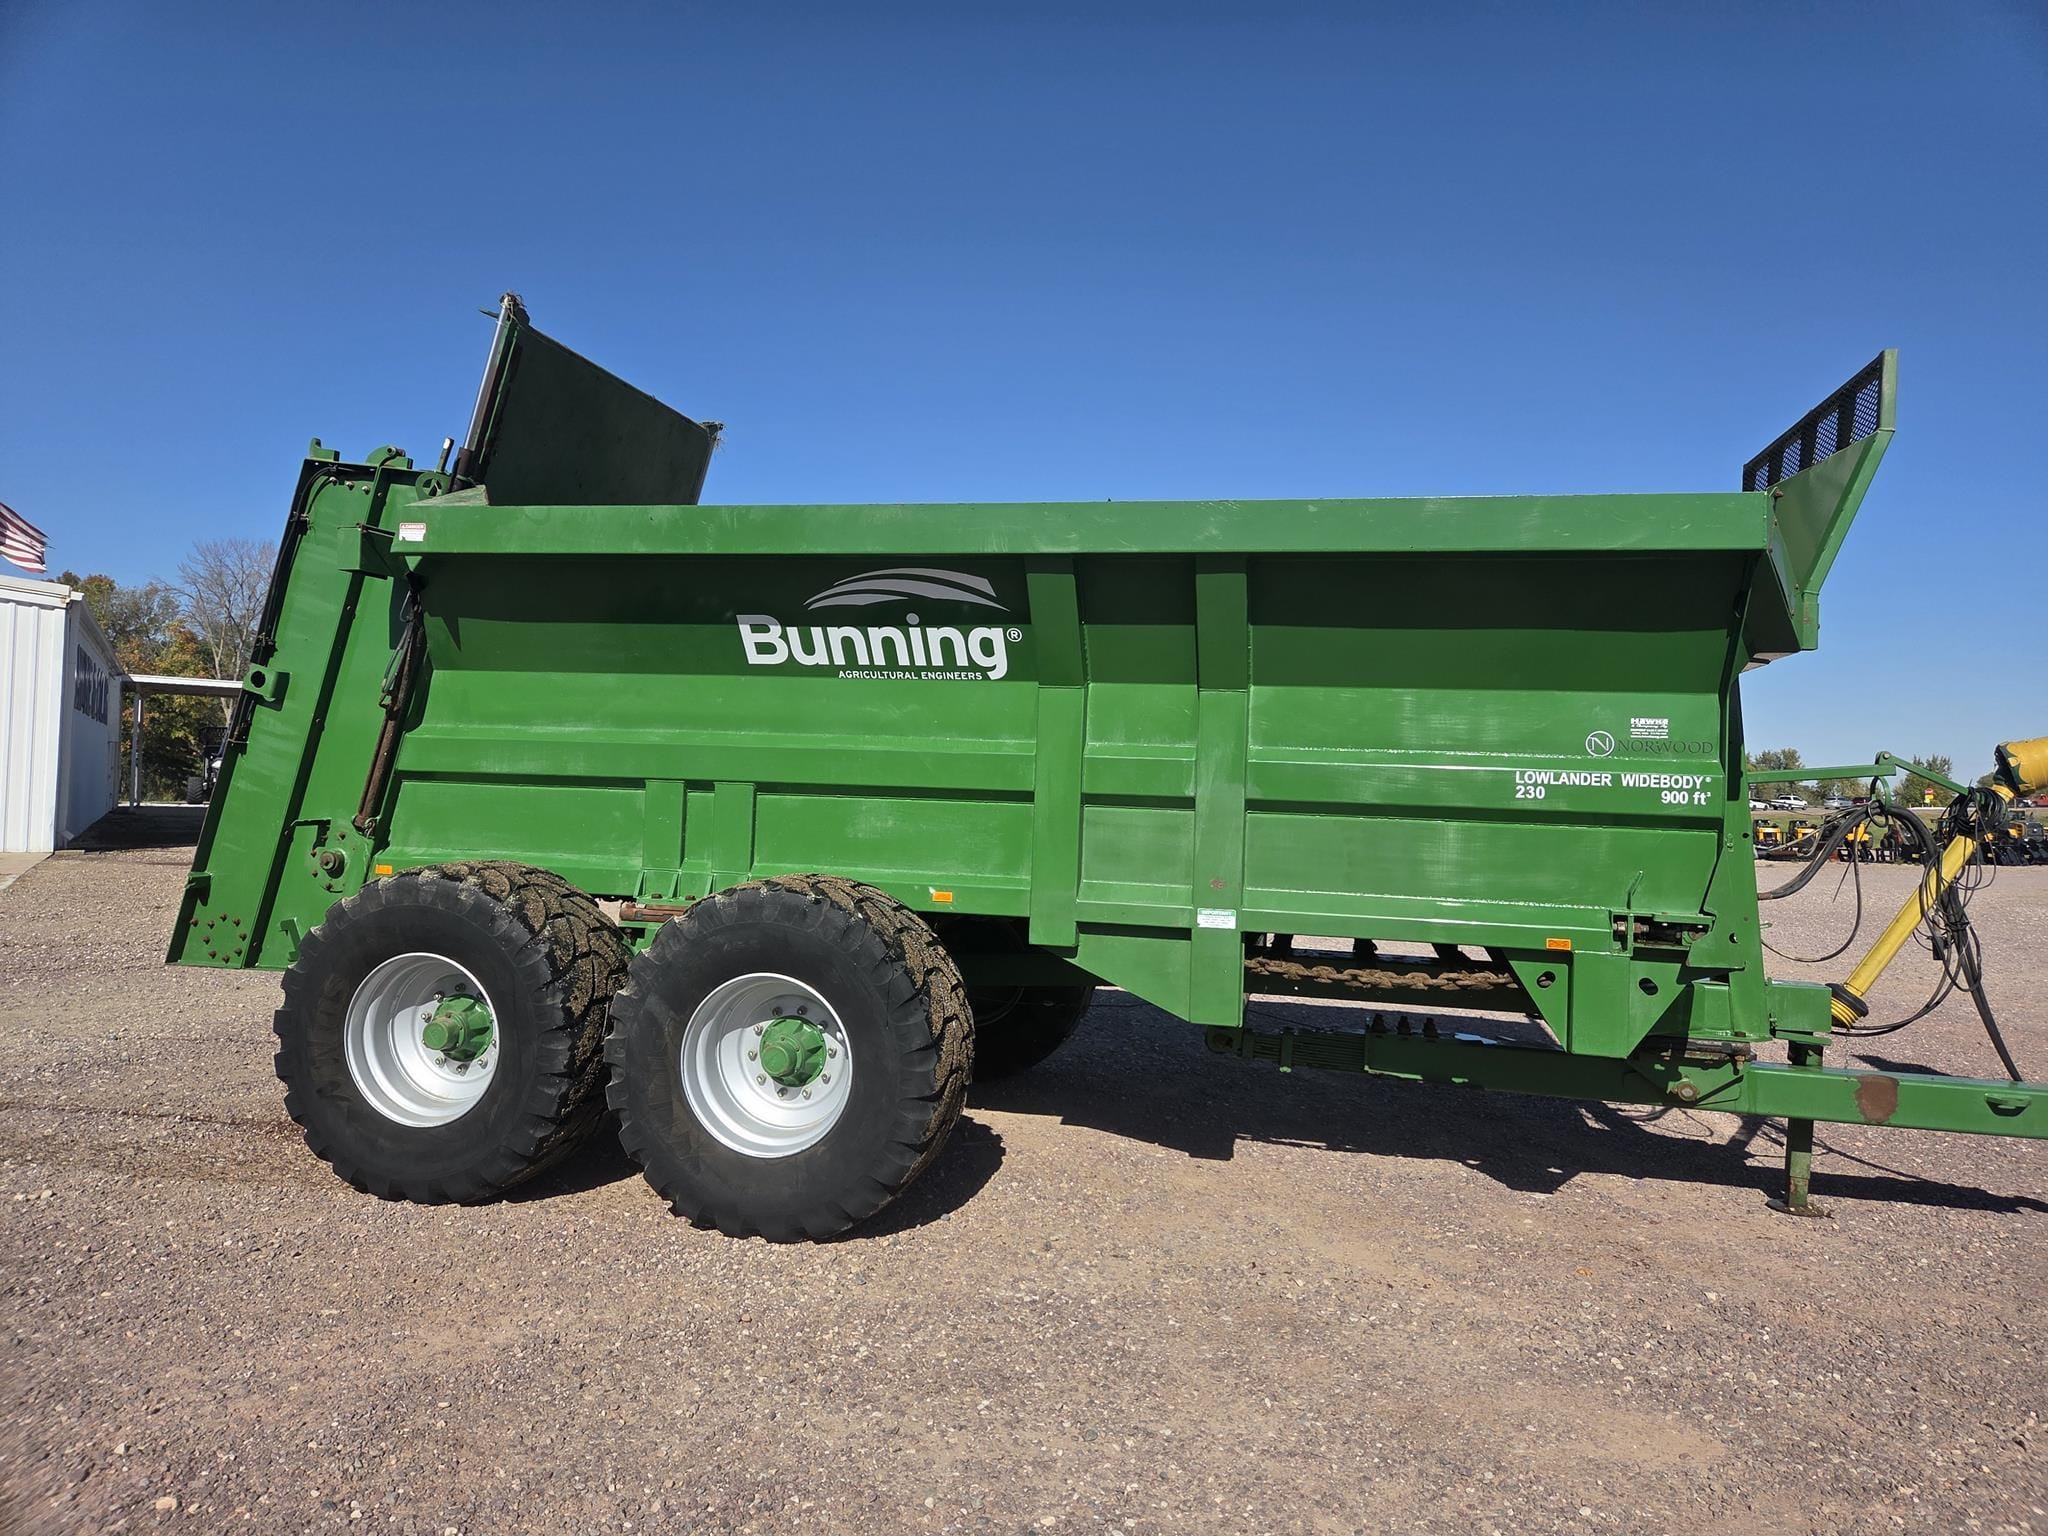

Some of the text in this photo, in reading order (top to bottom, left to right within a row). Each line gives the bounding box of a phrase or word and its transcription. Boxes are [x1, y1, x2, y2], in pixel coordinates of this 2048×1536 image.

[838, 670, 983, 680] AGRICULTURAL ENGINEERS
[1618, 739, 1714, 754] NORWOOD
[1515, 771, 1612, 787] LOWLANDER
[1515, 785, 1546, 799] 230
[1660, 790, 1689, 805] 900
